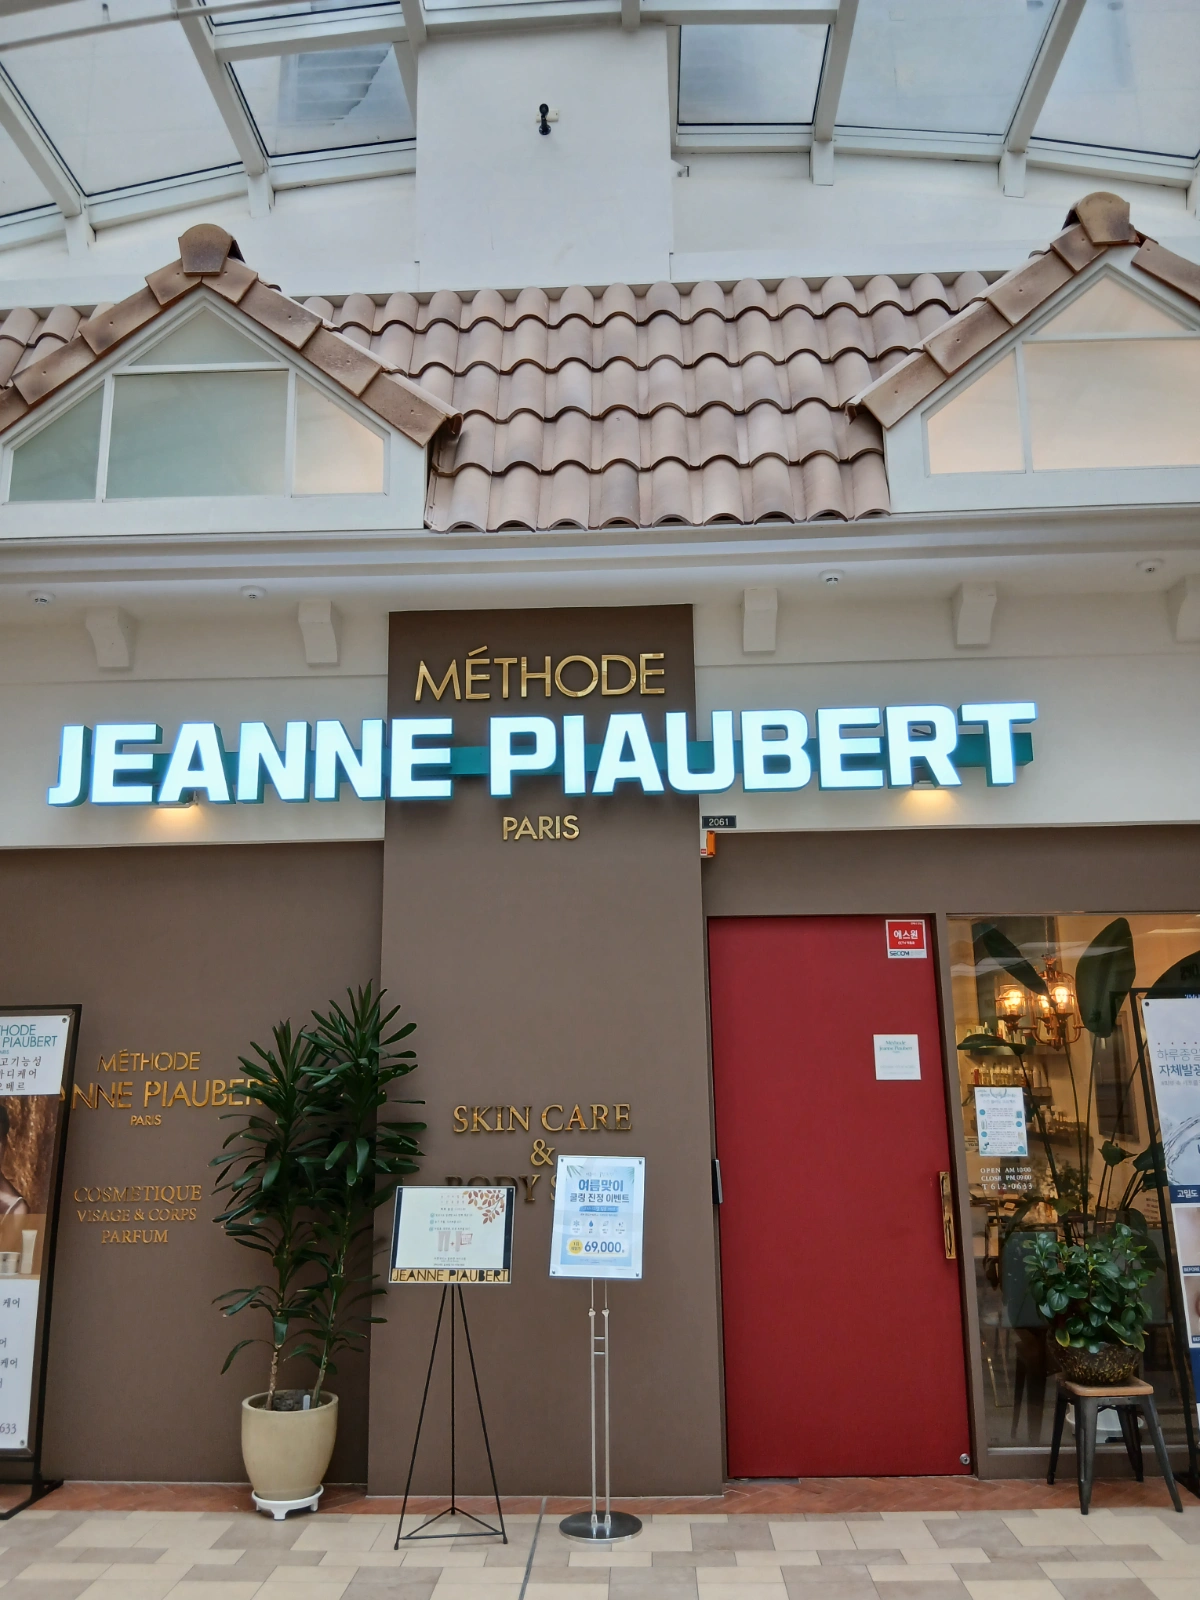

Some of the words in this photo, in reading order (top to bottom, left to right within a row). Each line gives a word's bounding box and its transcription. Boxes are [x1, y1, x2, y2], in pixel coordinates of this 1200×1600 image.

[414, 645, 666, 701] MÉTHODE
[47, 717, 454, 806] JEANNE
[488, 701, 1037, 797] PIAUBERT
[502, 814, 580, 841] PARIS
[708, 818, 729, 826] 2061
[893, 929, 918, 940] 에스원
[2, 1035, 58, 1048] PIAUBERT
[97, 1049, 201, 1072] MÉTHODE
[130, 1114, 162, 1127] PARIS
[453, 1104, 531, 1133] SKIN
[541, 1103, 633, 1131] CARE
[530, 1139, 555, 1167] &
[578, 1179, 624, 1192] 여름맞이
[74, 1184, 202, 1204] COSMETIQUE
[588, 1193, 604, 1203] 진정
[605, 1193, 630, 1204] 이벤트
[1177, 1189, 1199, 1199] 고밀도
[76, 1208, 131, 1222] VISAGE
[133, 1208, 145, 1221] &
[148, 1207, 197, 1221] CORPS
[101, 1229, 169, 1244] PARFUM
[392, 1268, 444, 1282] JEANNE
[448, 1268, 509, 1282] PIAUBERT
[3, 1298, 21, 1308] 케어
